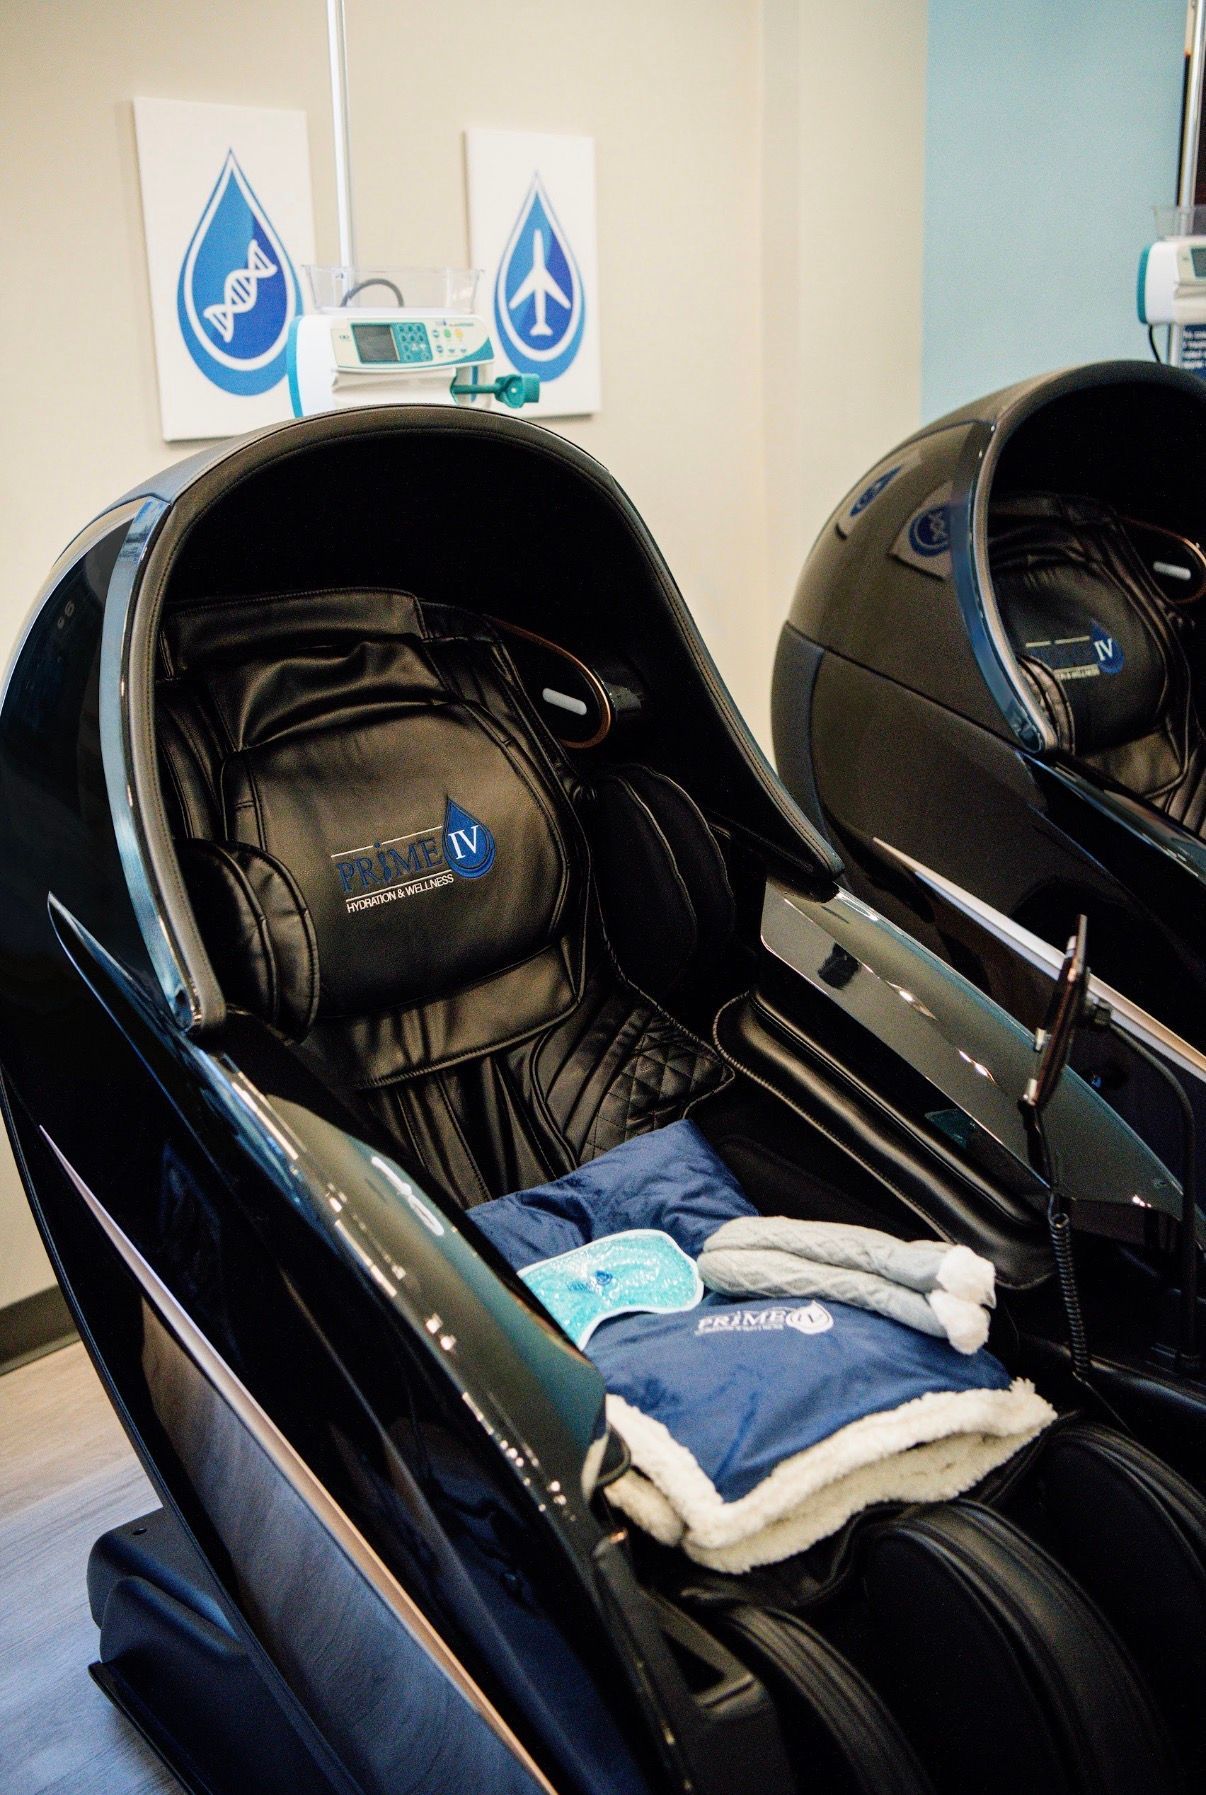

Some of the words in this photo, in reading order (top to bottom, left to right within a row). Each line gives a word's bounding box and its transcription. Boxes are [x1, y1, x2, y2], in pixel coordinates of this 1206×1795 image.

[1094, 638, 1113, 661] IV
[448, 825, 479, 860] IV
[346, 891, 397, 913] HYDRATION
[397, 888, 406, 899] &
[405, 873, 455, 896] WELLNESS
